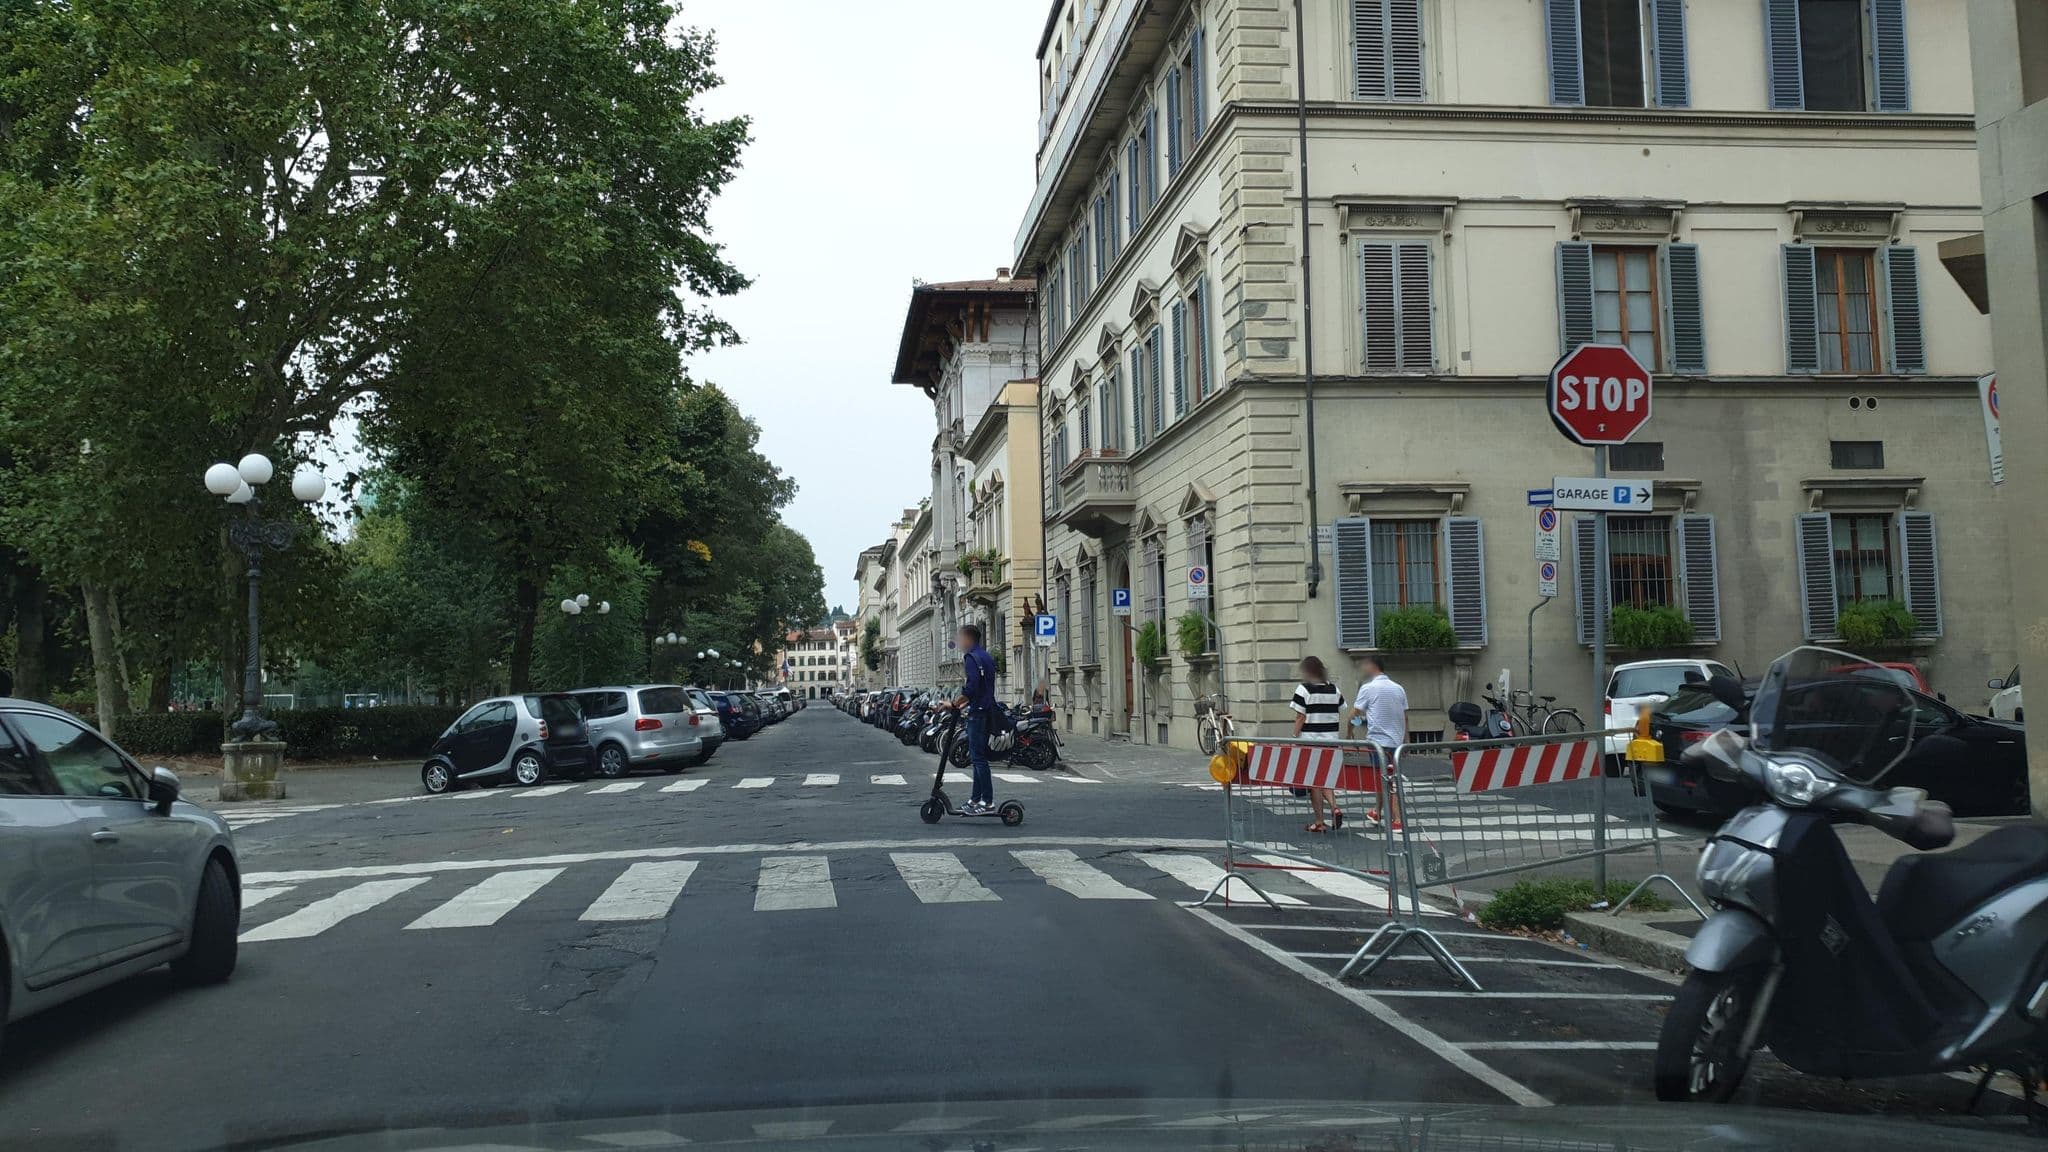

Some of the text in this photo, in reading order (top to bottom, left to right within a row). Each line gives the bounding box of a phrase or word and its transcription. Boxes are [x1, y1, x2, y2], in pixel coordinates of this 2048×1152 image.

[1561, 375, 1645, 412] STOP
[1556, 488, 1609, 500] GARAGE
[1116, 591, 1127, 606] P
[1039, 616, 1054, 635] P
